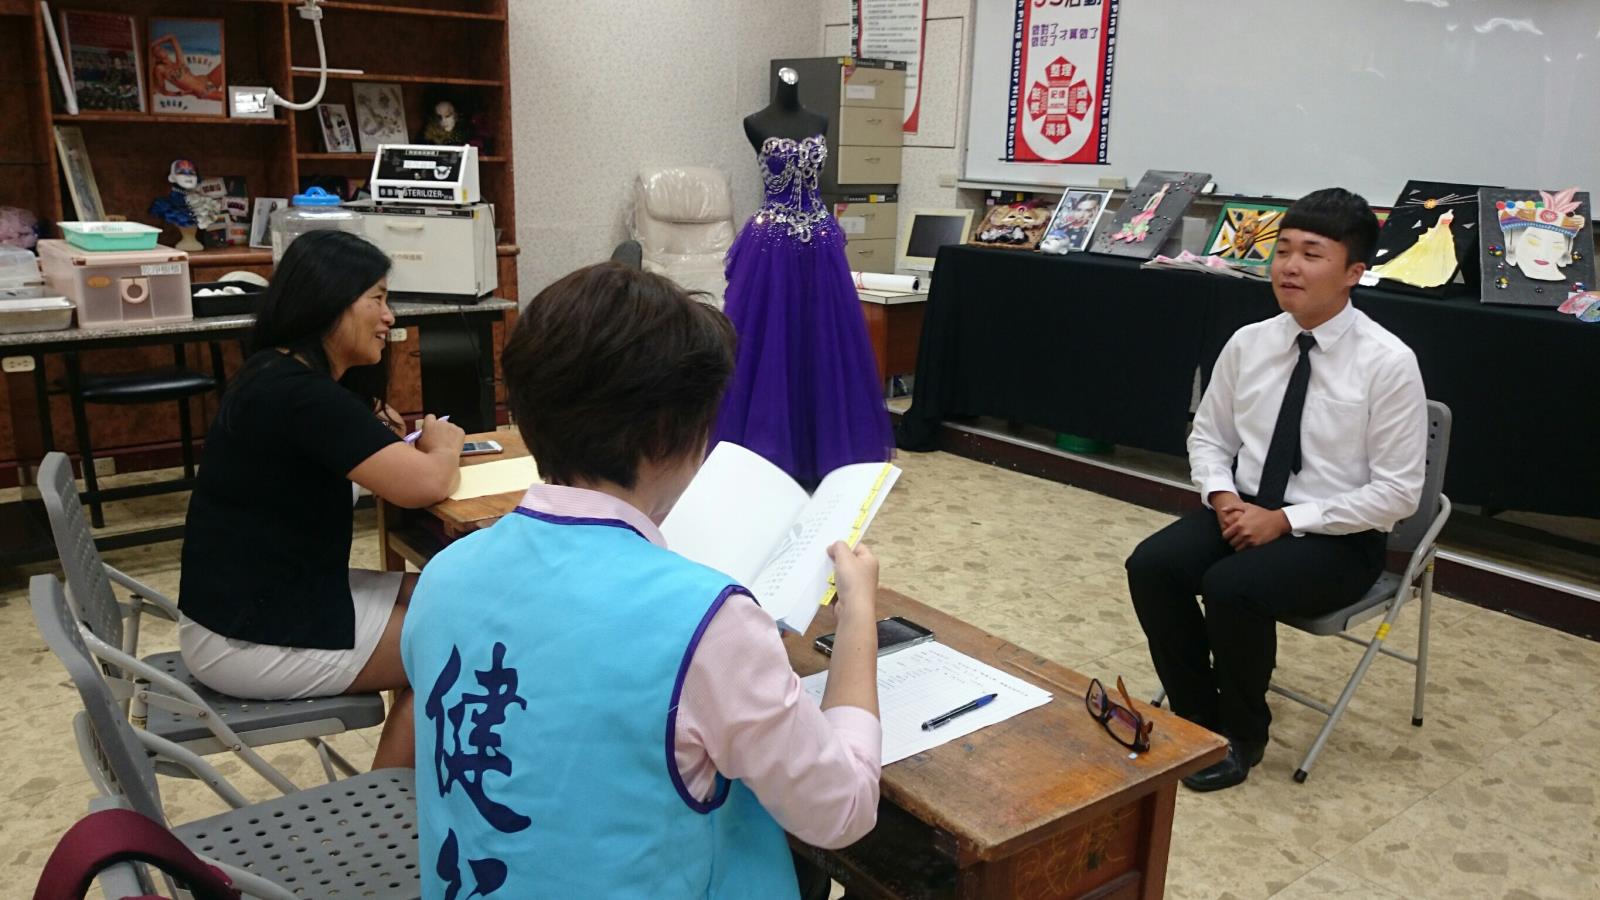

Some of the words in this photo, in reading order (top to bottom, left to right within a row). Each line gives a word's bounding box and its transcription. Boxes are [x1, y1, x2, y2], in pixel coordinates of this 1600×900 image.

[1012, 41, 1022, 83] Senior
[1105, 37, 1115, 81] Senior
[1010, 86, 1019, 114] High
[1102, 84, 1111, 115] High
[1007, 117, 1016, 160] School
[1099, 117, 1108, 162] School
